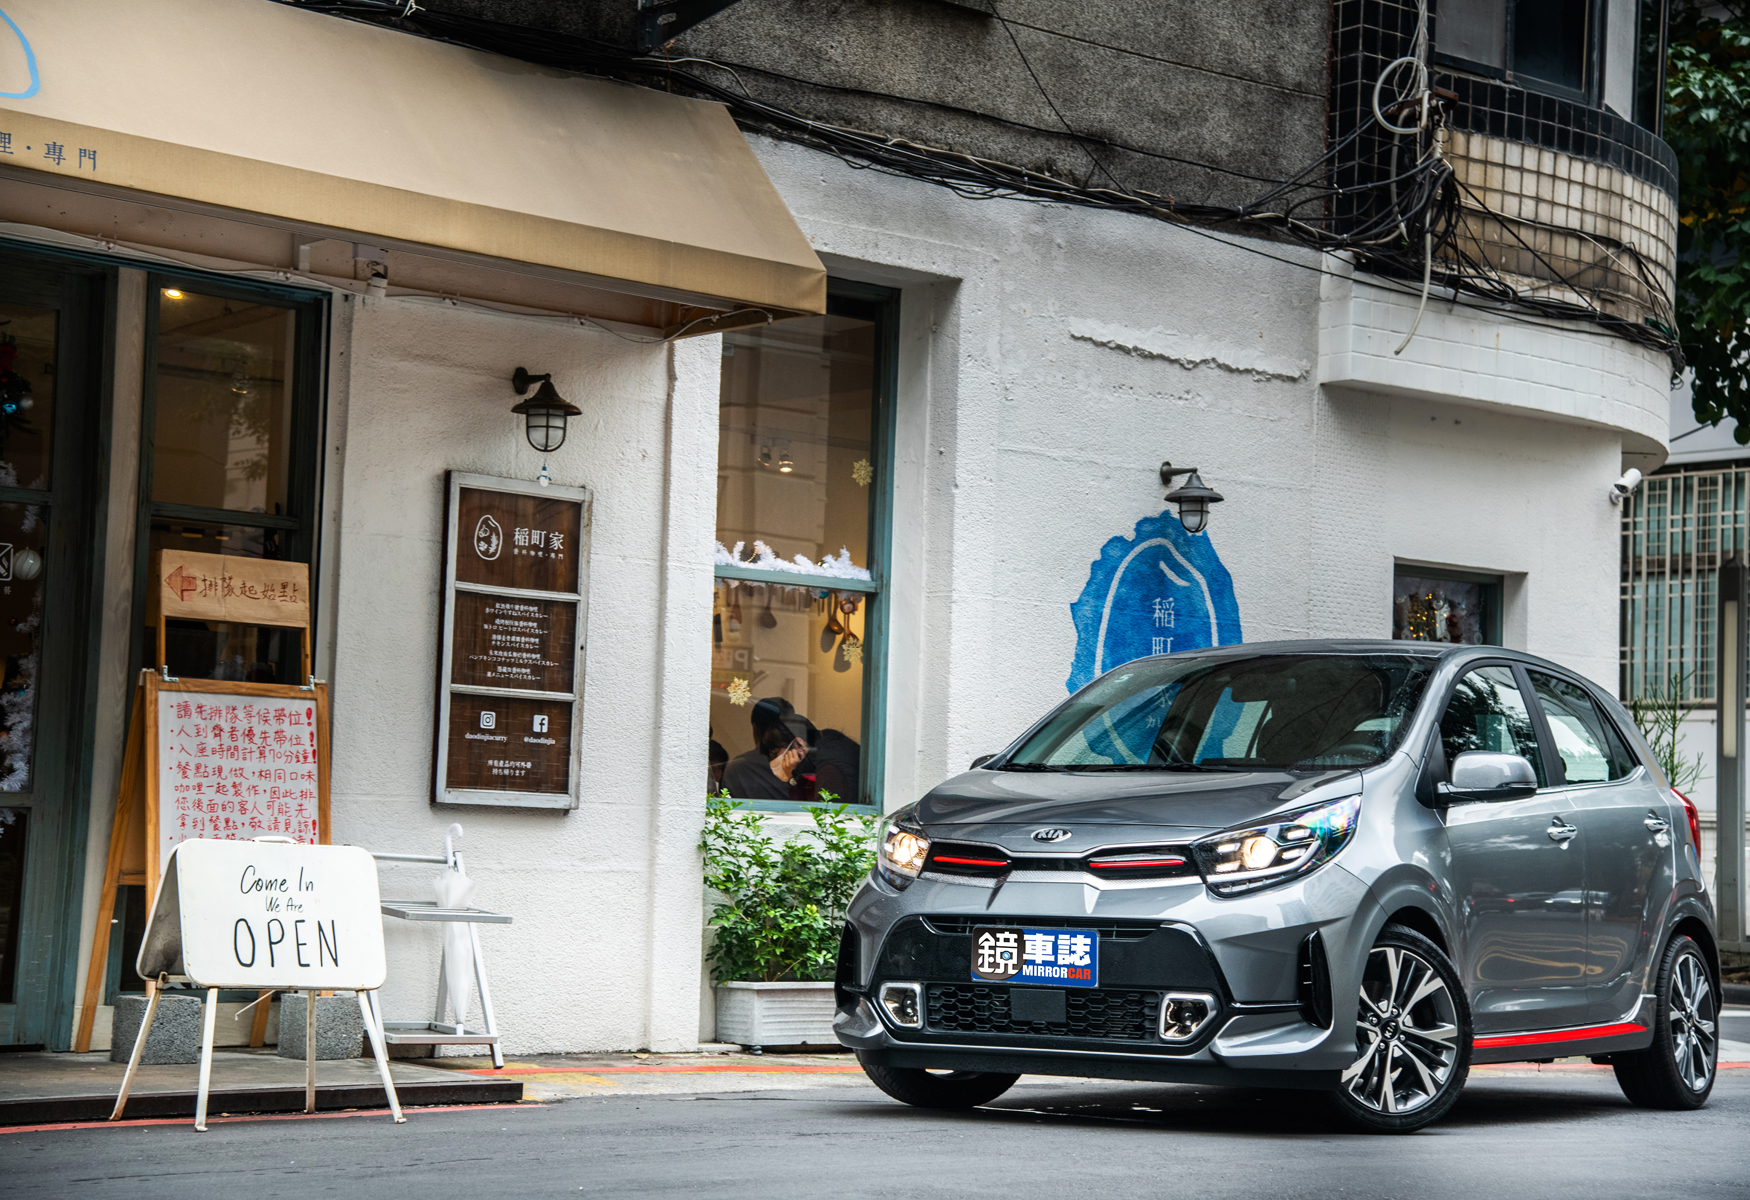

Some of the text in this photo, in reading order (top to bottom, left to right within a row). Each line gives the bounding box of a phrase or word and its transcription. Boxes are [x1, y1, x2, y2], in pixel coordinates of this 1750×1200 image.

[200, 574, 299, 603] 排隊起始點
[240, 864, 314, 894] Come In
[265, 895, 304, 913] We Are
[234, 918, 339, 968] OPEN
[1022, 965, 1091, 980] MIRRORCAR
